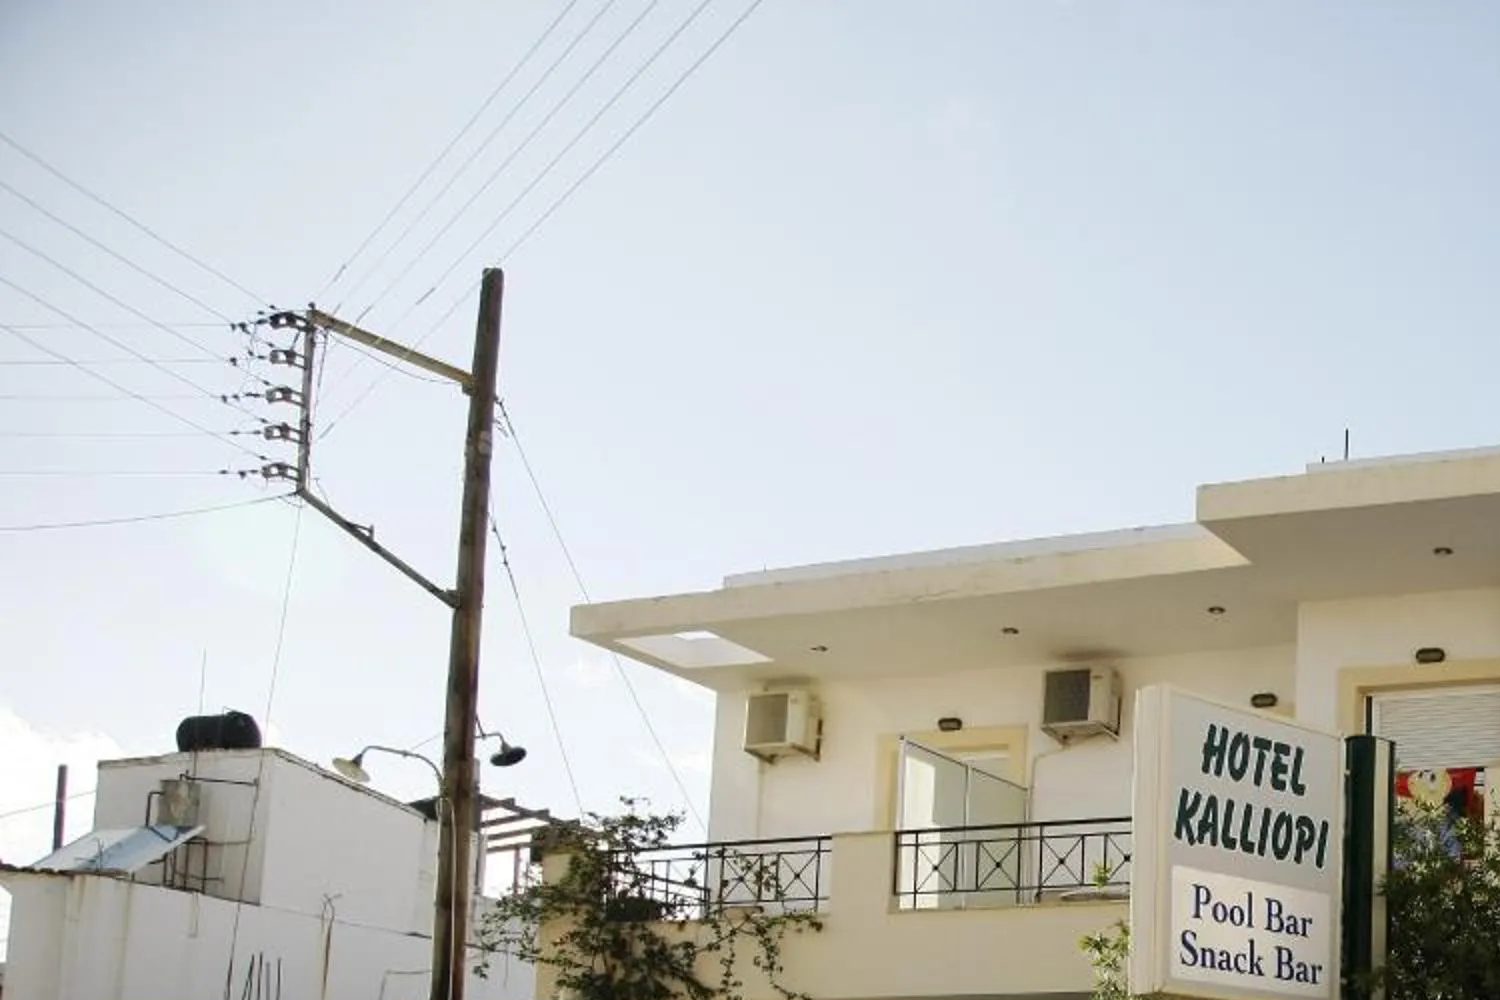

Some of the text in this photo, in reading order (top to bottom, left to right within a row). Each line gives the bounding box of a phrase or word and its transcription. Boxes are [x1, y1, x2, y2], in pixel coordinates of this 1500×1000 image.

[1201, 723, 1306, 796] HOTEL
[1173, 788, 1329, 869] KALLIOPI
[1192, 883, 1313, 938] Pool Bar
[1179, 929, 1323, 985] Snack Bar
